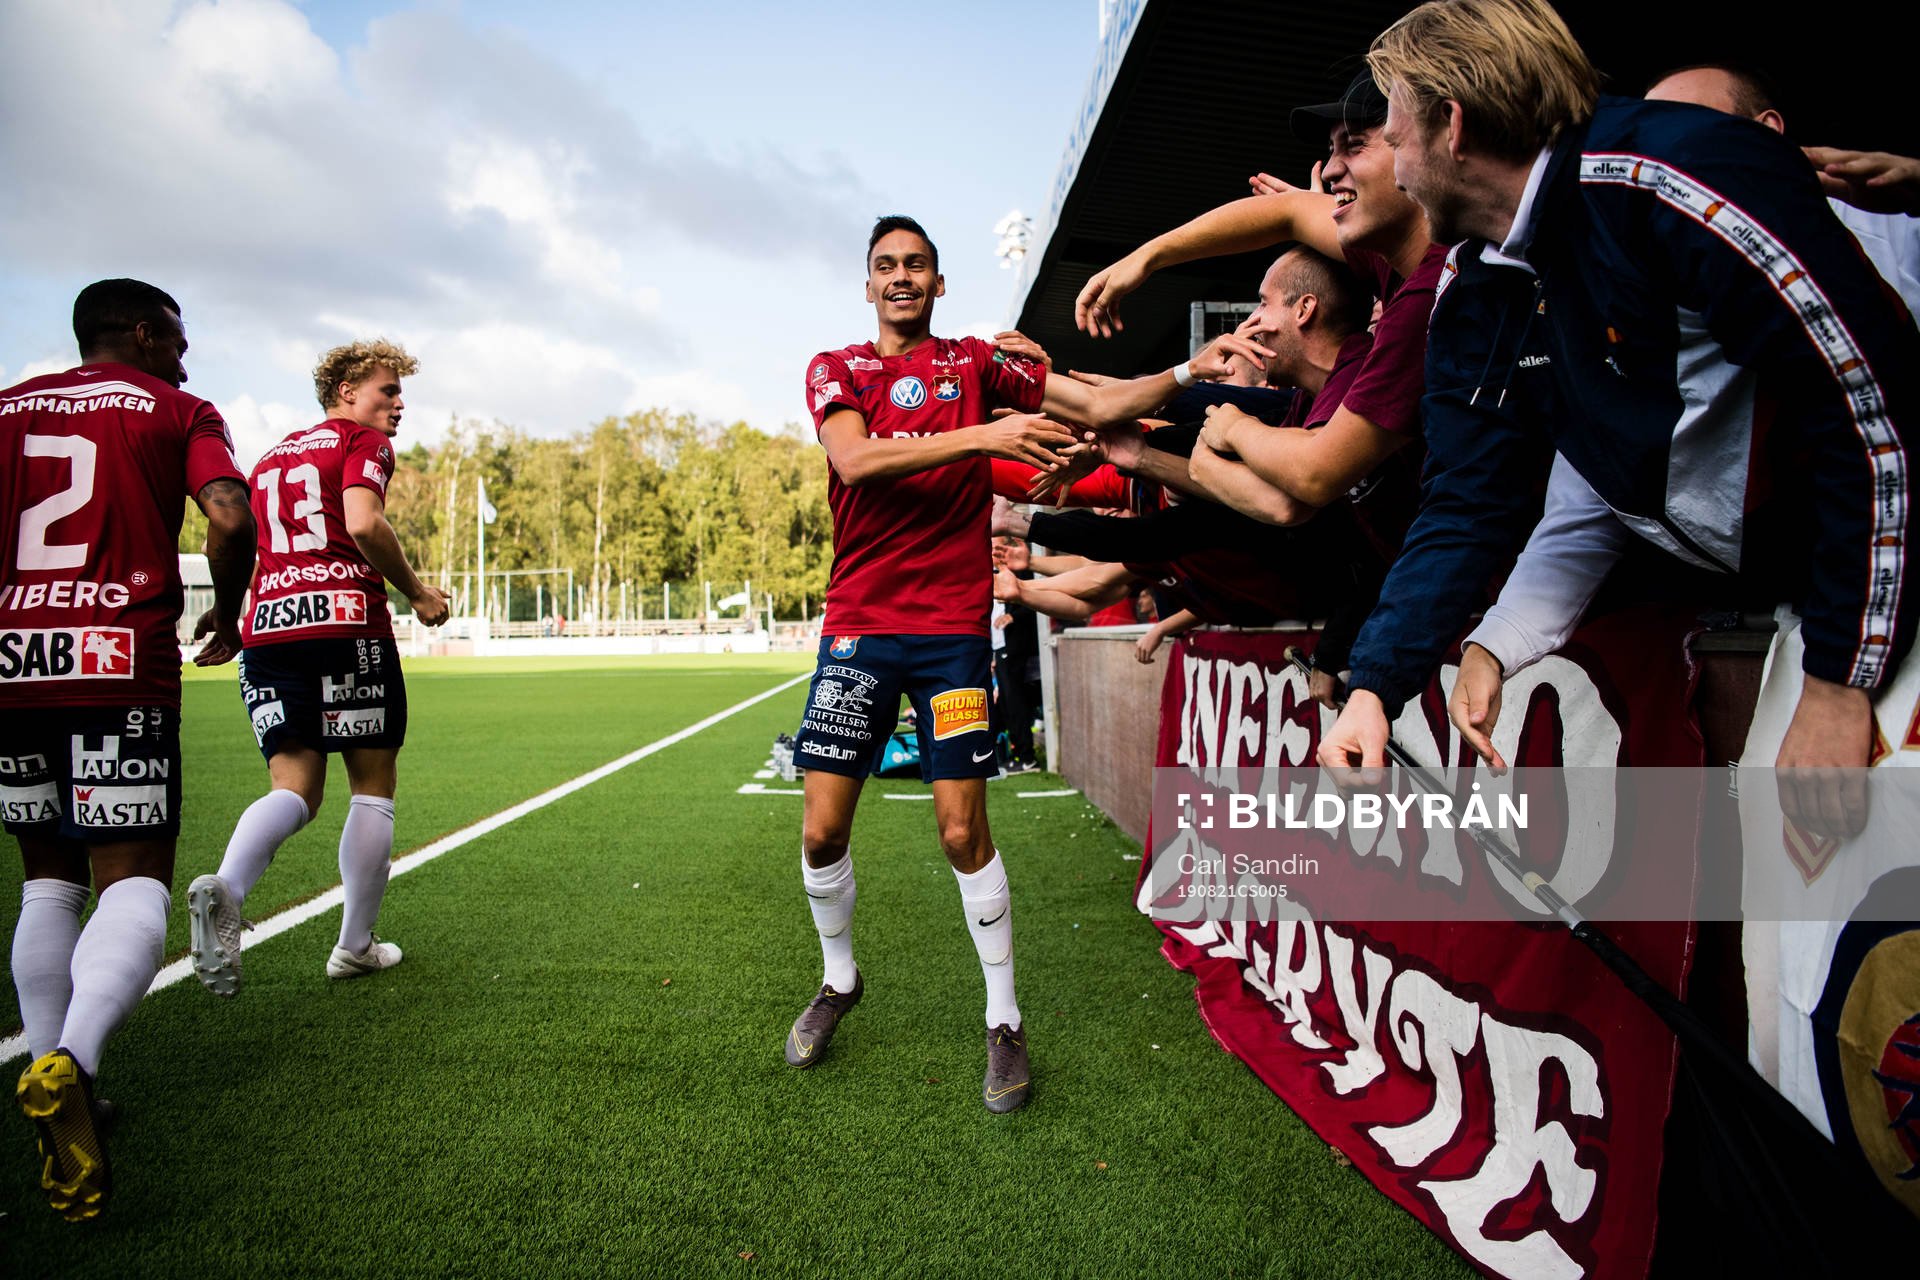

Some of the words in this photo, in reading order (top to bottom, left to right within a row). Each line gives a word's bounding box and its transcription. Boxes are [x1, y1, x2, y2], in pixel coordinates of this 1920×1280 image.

[1732, 223, 1777, 264] ellesse
[1804, 299, 1837, 344] ellesse
[0, 395, 156, 416] AMMARVIKEN
[17, 434, 97, 571] 2
[257, 462, 328, 554] 13
[1884, 470, 1898, 520] ellesse
[1876, 567, 1893, 617] ellesse
[254, 594, 331, 632] BESAB
[828, 667, 847, 676] FAIR
[849, 671, 871, 683] PLAY
[808, 709, 869, 729] STIFTELSEN
[935, 696, 984, 714] TRIUMF
[943, 710, 980, 723] GLASS
[327, 718, 383, 736] RASTA
[72, 734, 169, 780] HAJON
[801, 740, 857, 761] stadium
[77, 801, 166, 825] RASTA
